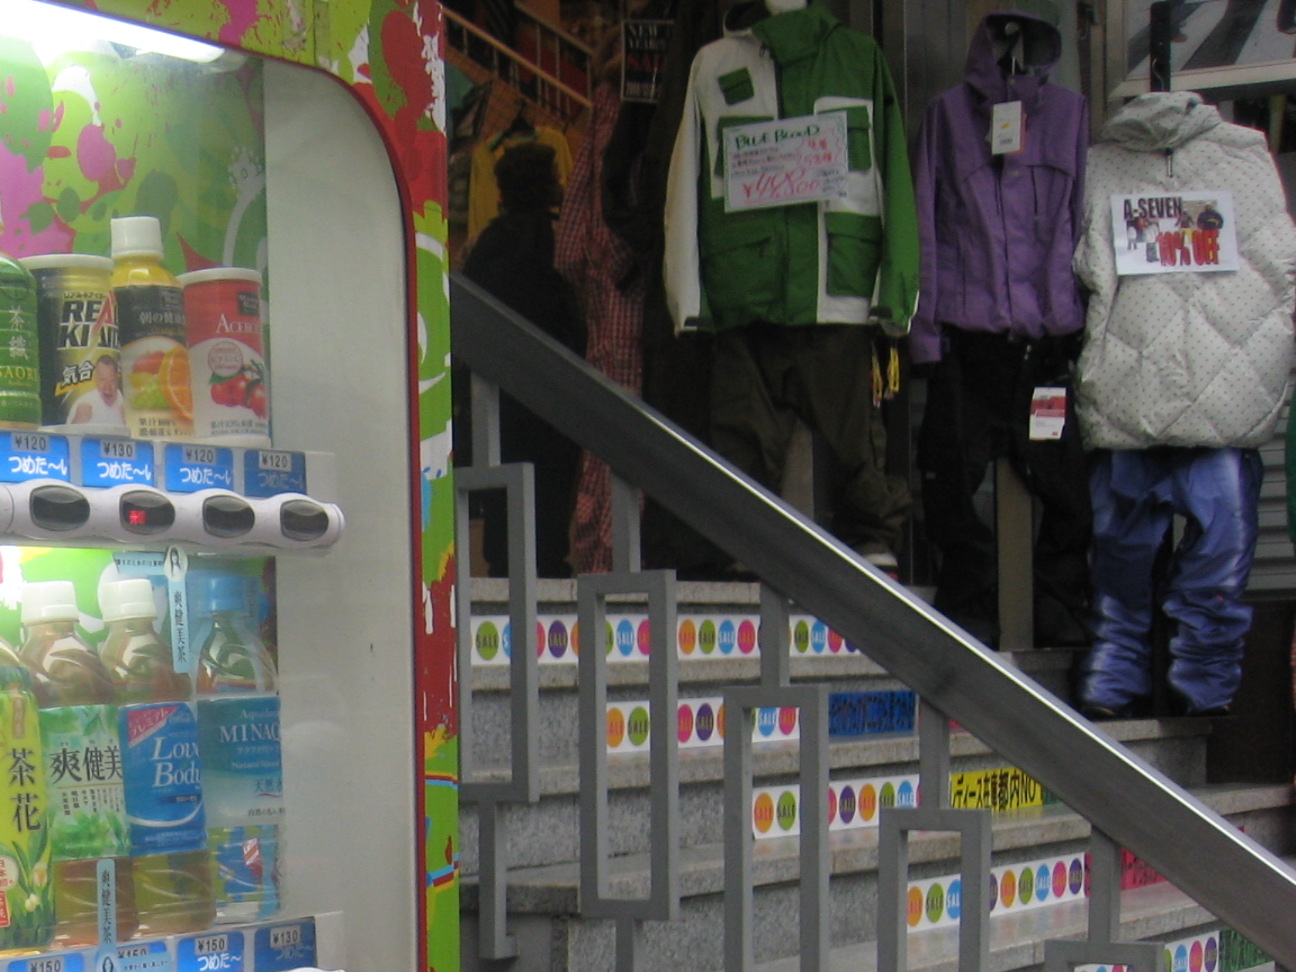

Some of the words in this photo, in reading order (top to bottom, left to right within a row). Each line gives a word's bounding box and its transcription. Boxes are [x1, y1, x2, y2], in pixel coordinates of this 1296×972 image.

[1124, 196, 1183, 220] A-SEVEN
[14, 436, 47, 450] ¥120
[103, 443, 133, 457] ¥130
[186, 450, 213, 463] ¥120
[476, 633, 498, 649] SALE
[616, 631, 634, 647] SALE
[718, 631, 735, 646] SALE
[628, 719, 648, 734] SALE
[758, 714, 776, 727] SALE
[7, 747, 41, 832] 茶花
[777, 804, 795, 818] SALE
[926, 894, 944, 911] SALE
[198, 939, 226, 953] ¥150
